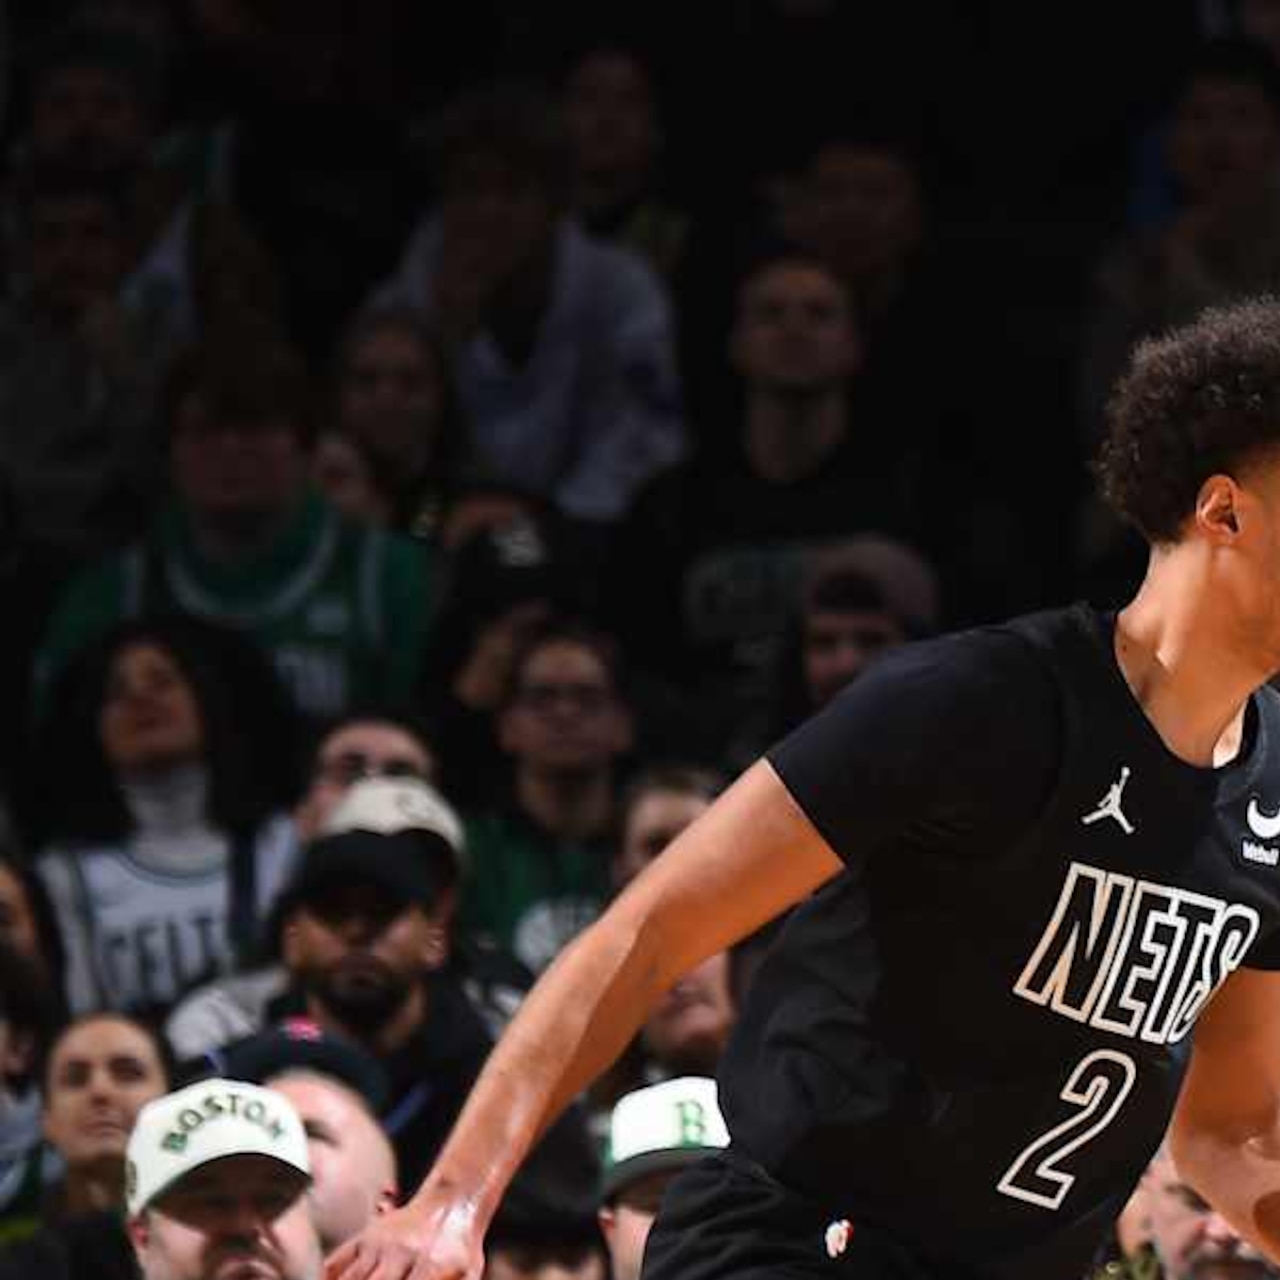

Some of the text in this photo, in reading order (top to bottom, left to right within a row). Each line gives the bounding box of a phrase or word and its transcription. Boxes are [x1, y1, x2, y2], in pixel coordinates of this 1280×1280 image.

[1012, 860, 1262, 1046] NETS
[162, 1095, 284, 1151] BOSTON
[676, 1100, 706, 1149] B
[997, 1048, 1138, 1211] 2
